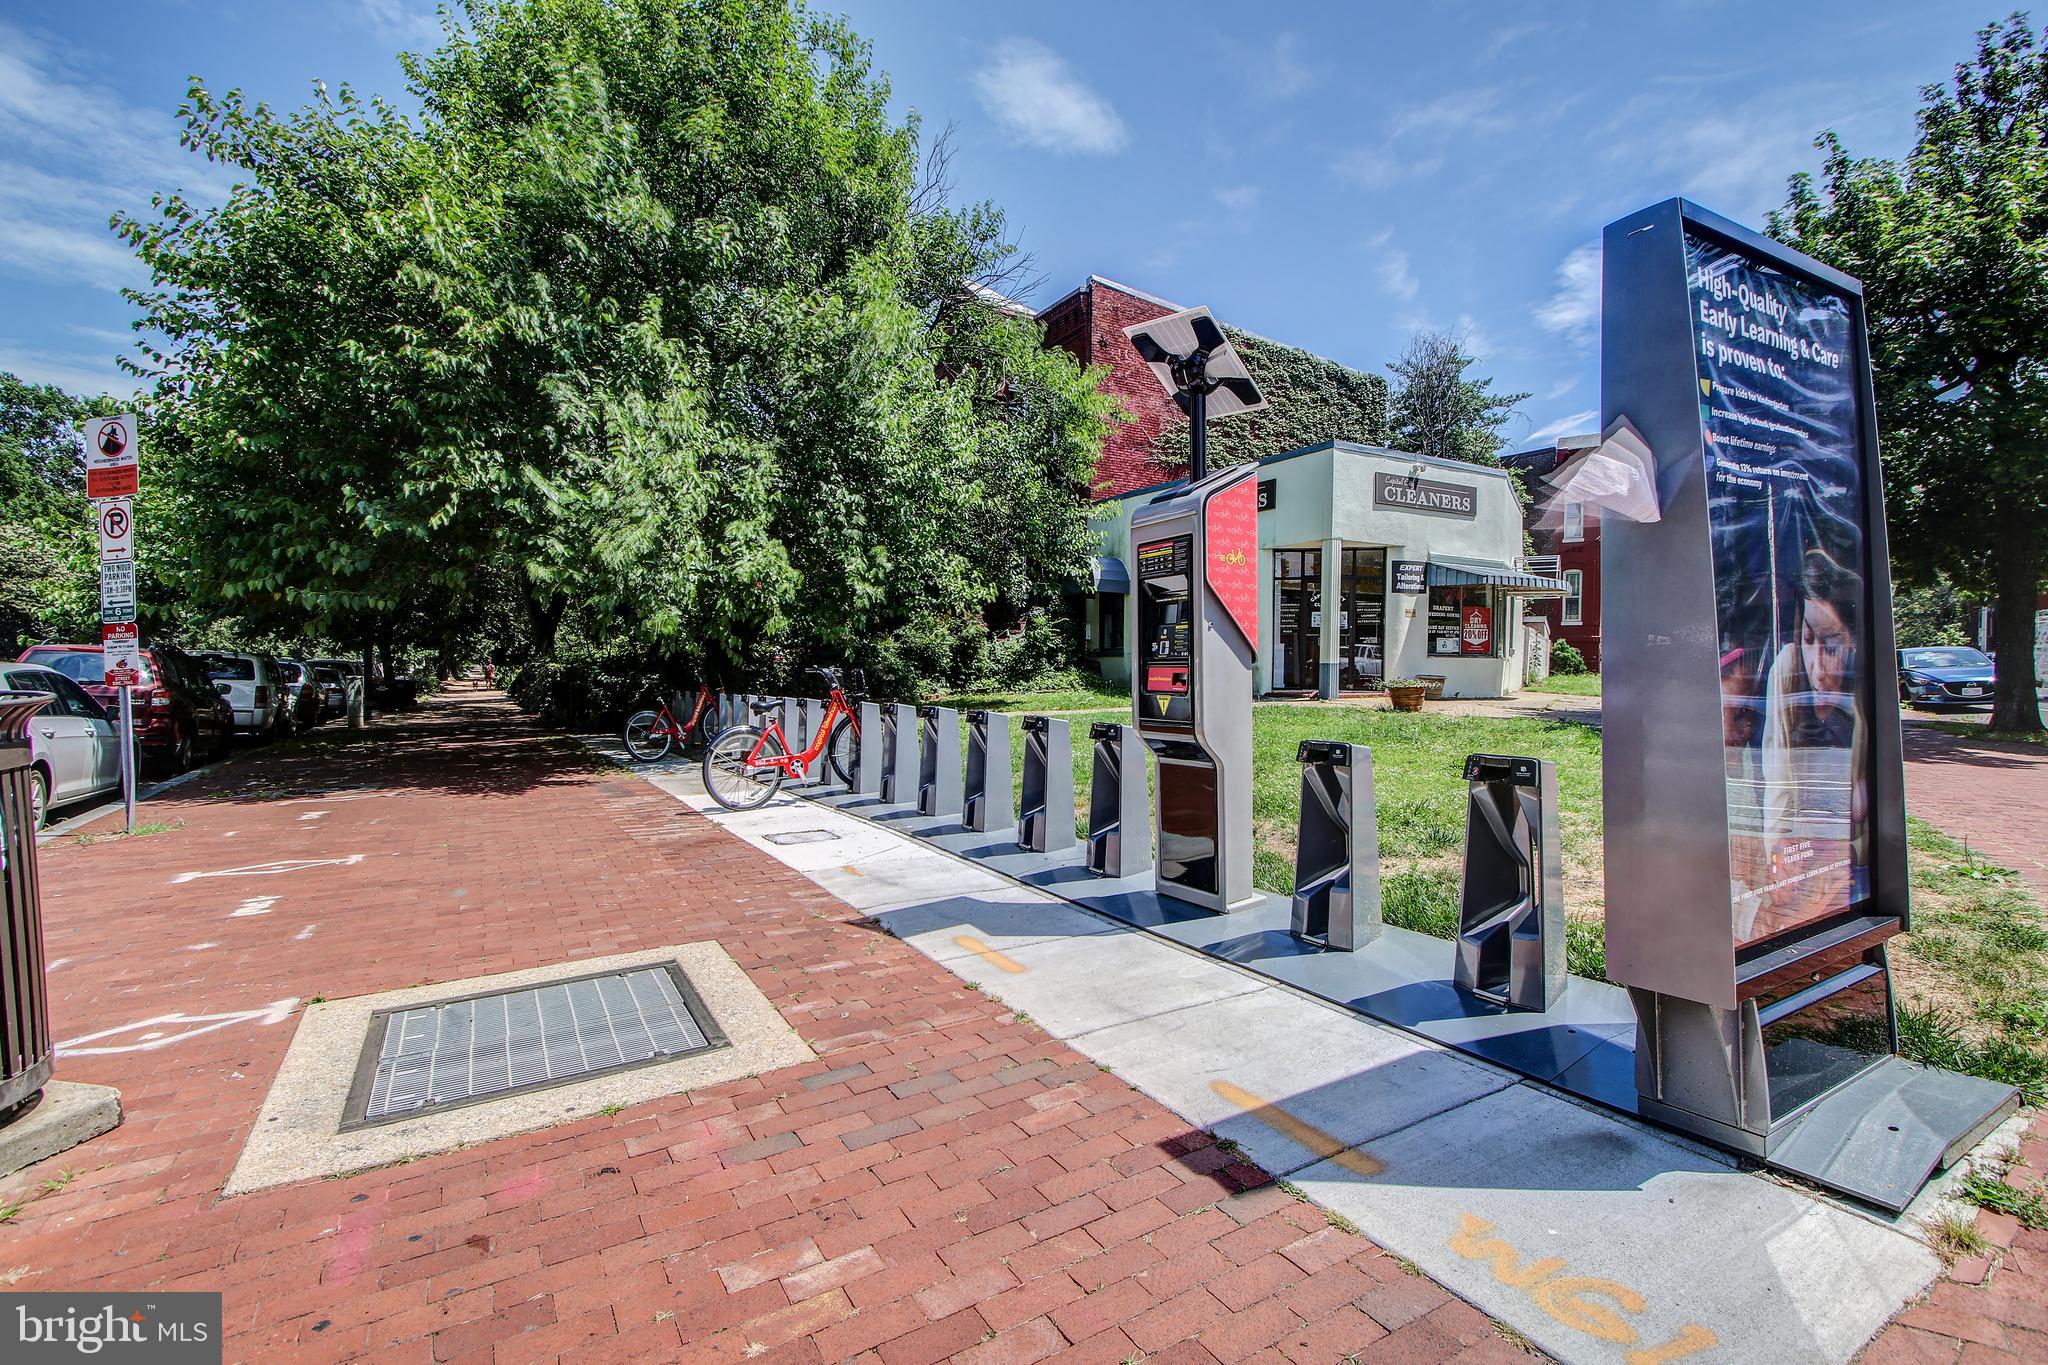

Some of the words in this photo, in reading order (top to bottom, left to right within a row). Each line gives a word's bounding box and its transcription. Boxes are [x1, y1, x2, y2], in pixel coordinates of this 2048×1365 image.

[1698, 266, 1787, 326] High-Quality
[1700, 299, 1737, 339] Early
[1741, 316, 1798, 360] Learning
[1800, 338, 1810, 360] &
[1812, 342, 1839, 369] Care
[1702, 331, 1715, 357] is
[1719, 343, 1767, 374] proven
[1767, 357, 1787, 380] to:
[1711, 407, 1738, 420] Increase
[1712, 432, 1730, 445] Boost
[1731, 435, 1754, 449] lifetime
[1384, 486, 1471, 512] CLEANERS
[104, 564, 115, 572] TWO
[1399, 564, 1423, 572] EXPERT
[104, 572, 131, 581] PARKING
[1396, 573, 1420, 582] Tailoring
[1396, 581, 1425, 590] Alterations
[115, 607, 121, 616] 6
[107, 632, 134, 640] PARKING
[1463, 629, 1477, 640] 20%
[1477, 629, 1488, 640] OFF
[1783, 844, 1798, 855] FIRST
[1800, 840, 1811, 850] FIVE
[1783, 853, 1801, 864] YEARS
[1801, 849, 1814, 860] FUND
